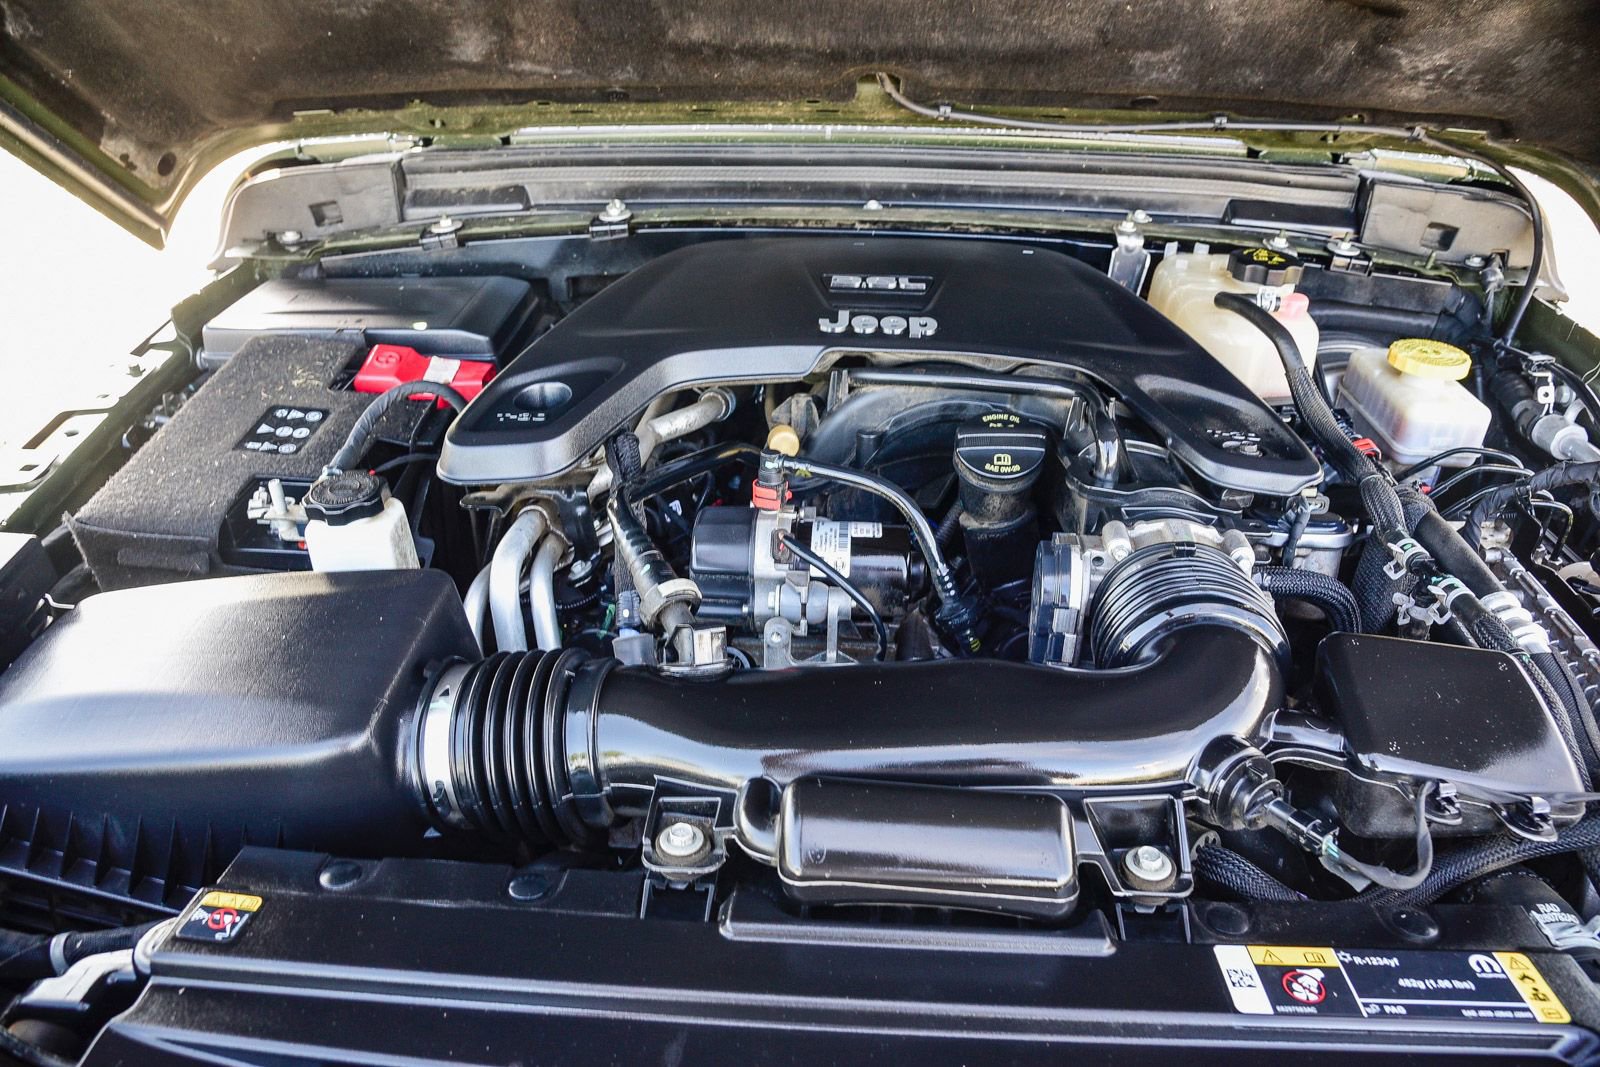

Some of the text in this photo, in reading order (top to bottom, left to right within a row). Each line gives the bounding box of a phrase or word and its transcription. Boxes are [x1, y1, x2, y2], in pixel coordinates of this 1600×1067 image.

[818, 309, 938, 338] Jeep
[982, 413, 1020, 423] ENGINE OIL
[984, 463, 1000, 472] SAE
[1536, 903, 1560, 914] RAD
[1352, 956, 1400, 967] R-1234yf
